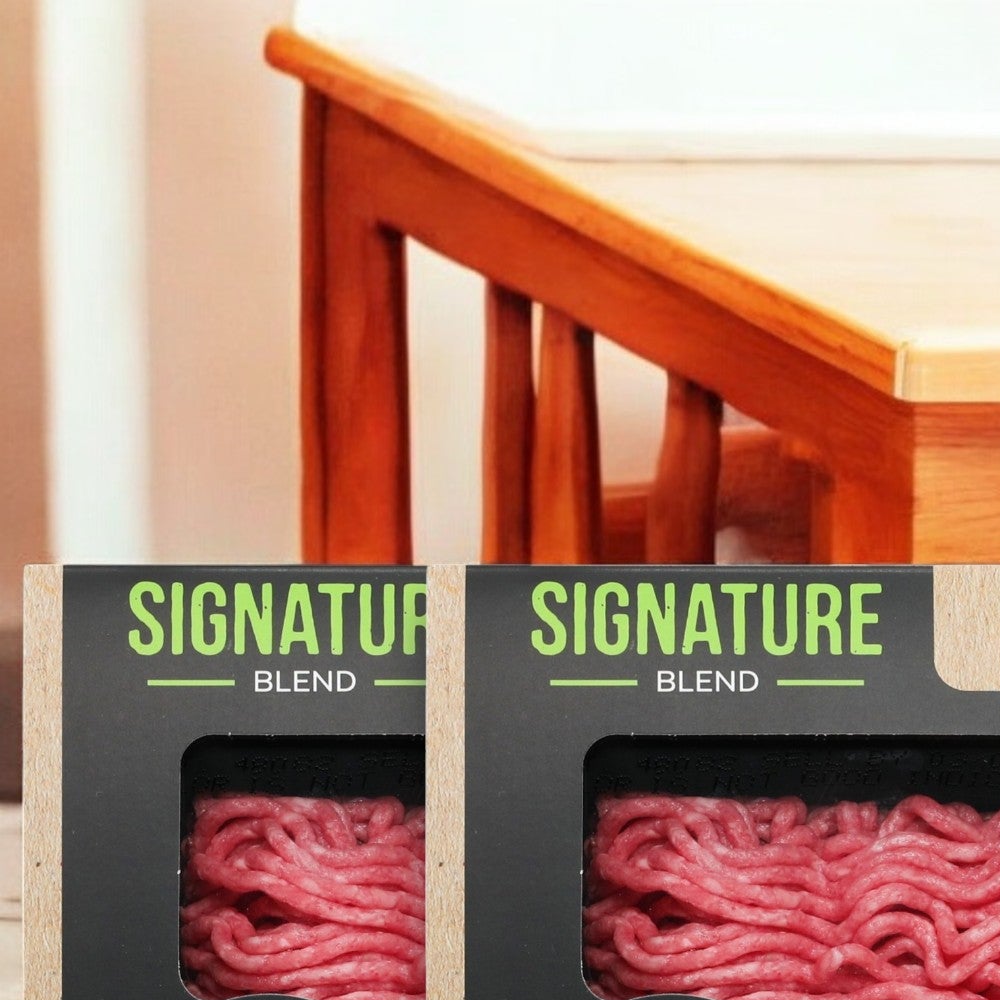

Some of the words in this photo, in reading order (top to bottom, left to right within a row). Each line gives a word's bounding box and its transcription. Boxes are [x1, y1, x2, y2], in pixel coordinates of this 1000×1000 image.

[129, 582, 426, 655] SIGNATUR
[532, 582, 882, 655] SIGNATURE
[255, 671, 356, 692] BLEND
[657, 671, 759, 692] BLEND
